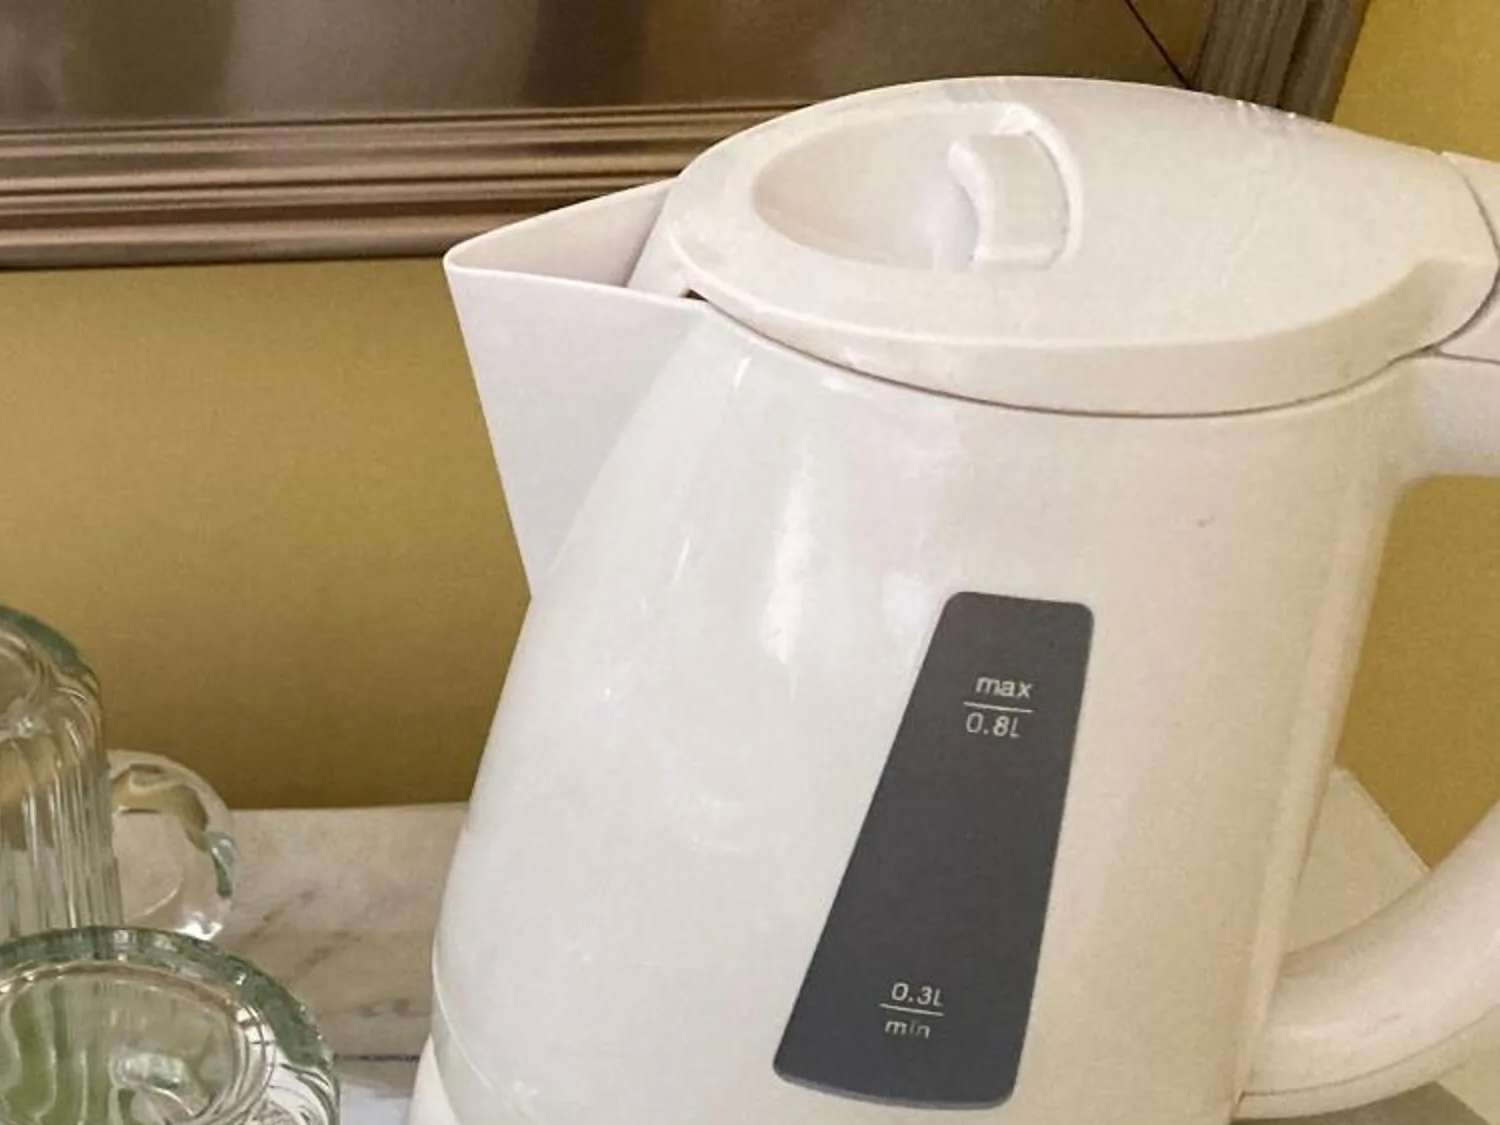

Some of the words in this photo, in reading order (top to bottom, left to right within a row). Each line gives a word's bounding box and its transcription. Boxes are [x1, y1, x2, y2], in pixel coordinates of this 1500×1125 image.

[976, 677, 1031, 698] max
[965, 711, 1021, 738] 0.8L
[891, 982, 944, 1007] 0.3L
[884, 1020, 931, 1039] min
